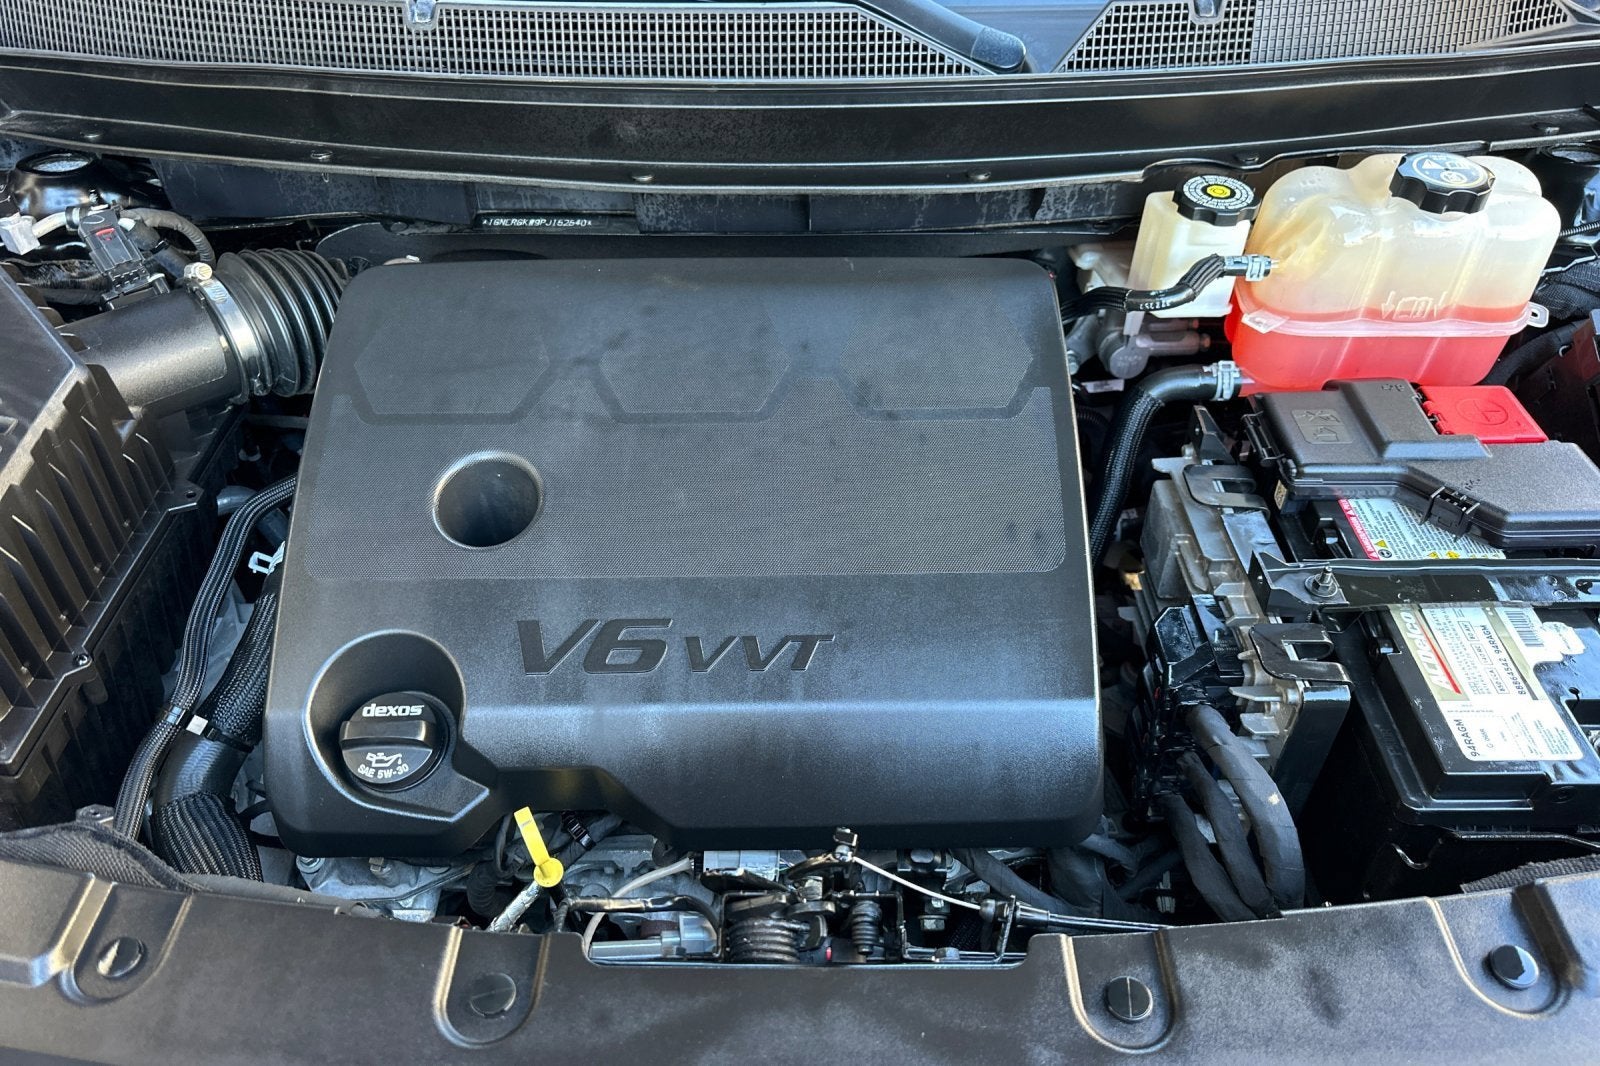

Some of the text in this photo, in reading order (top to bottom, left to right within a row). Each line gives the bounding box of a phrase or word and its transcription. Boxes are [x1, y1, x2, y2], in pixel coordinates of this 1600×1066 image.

[516, 618, 836, 675] V6 VVT
[1400, 612, 1452, 690] ACDelco
[1480, 624, 1502, 654] 94RAGM
[362, 703, 425, 717] dexos
[1453, 719, 1480, 756] 94RAGM
[358, 763, 409, 779] SAE 5W-30
